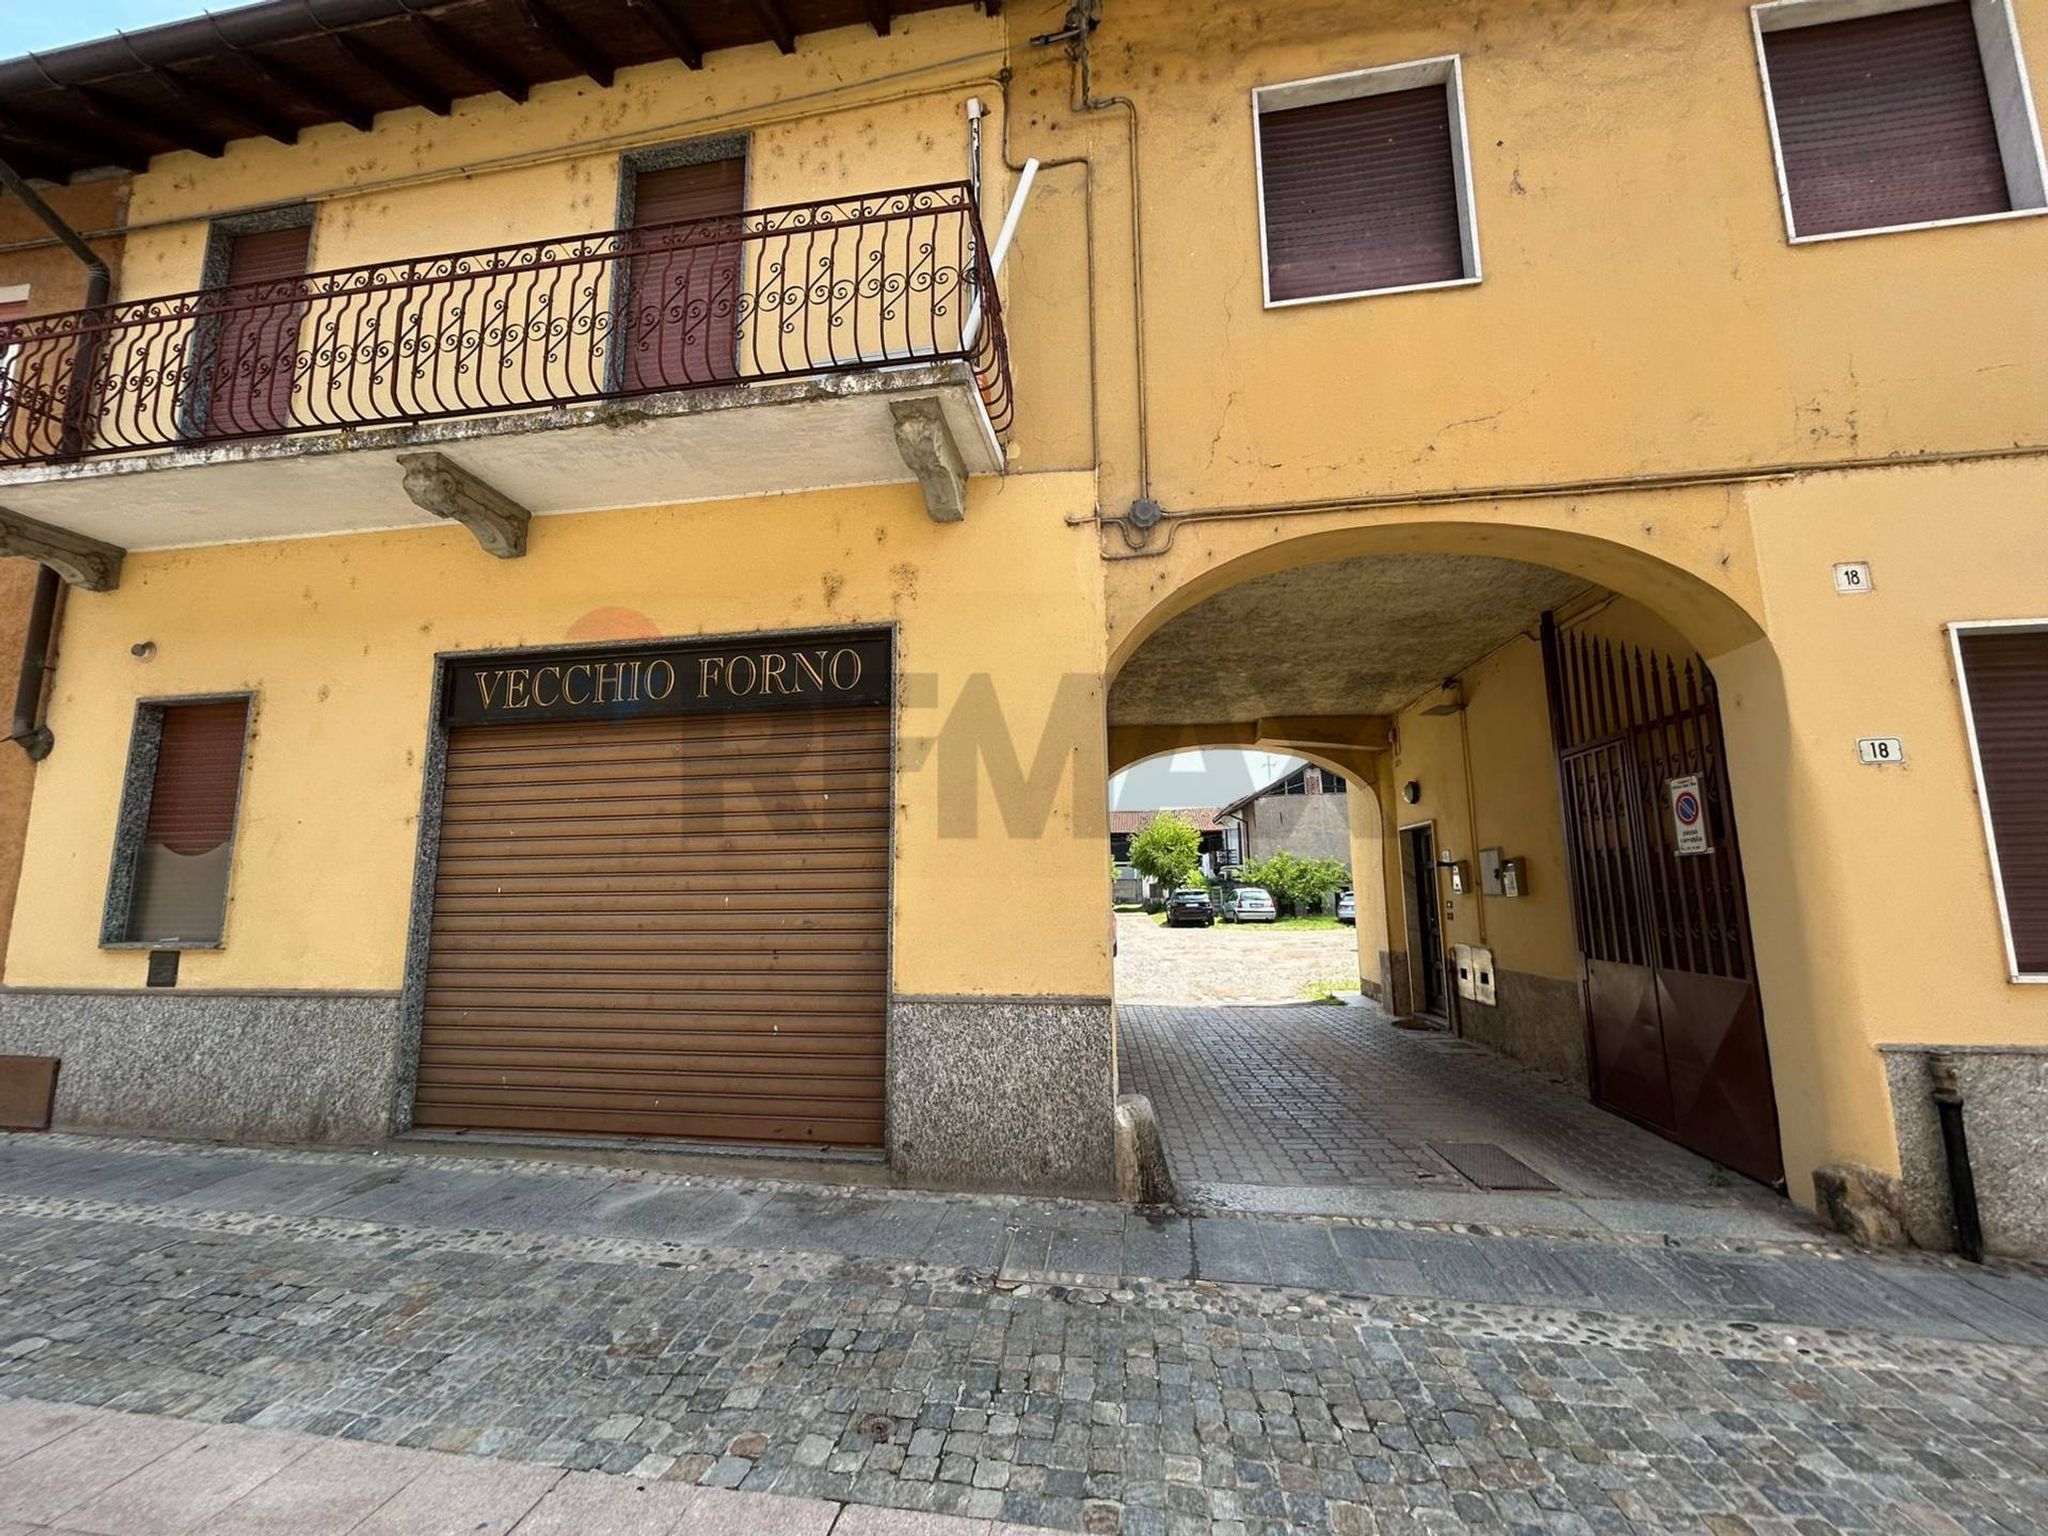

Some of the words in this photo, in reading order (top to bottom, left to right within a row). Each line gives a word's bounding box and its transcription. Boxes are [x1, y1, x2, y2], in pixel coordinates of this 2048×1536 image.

[1843, 569, 1861, 586] 18
[474, 659, 676, 711] VECCHIO
[697, 648, 862, 699] FORNO
[1870, 742, 1890, 759] 18
